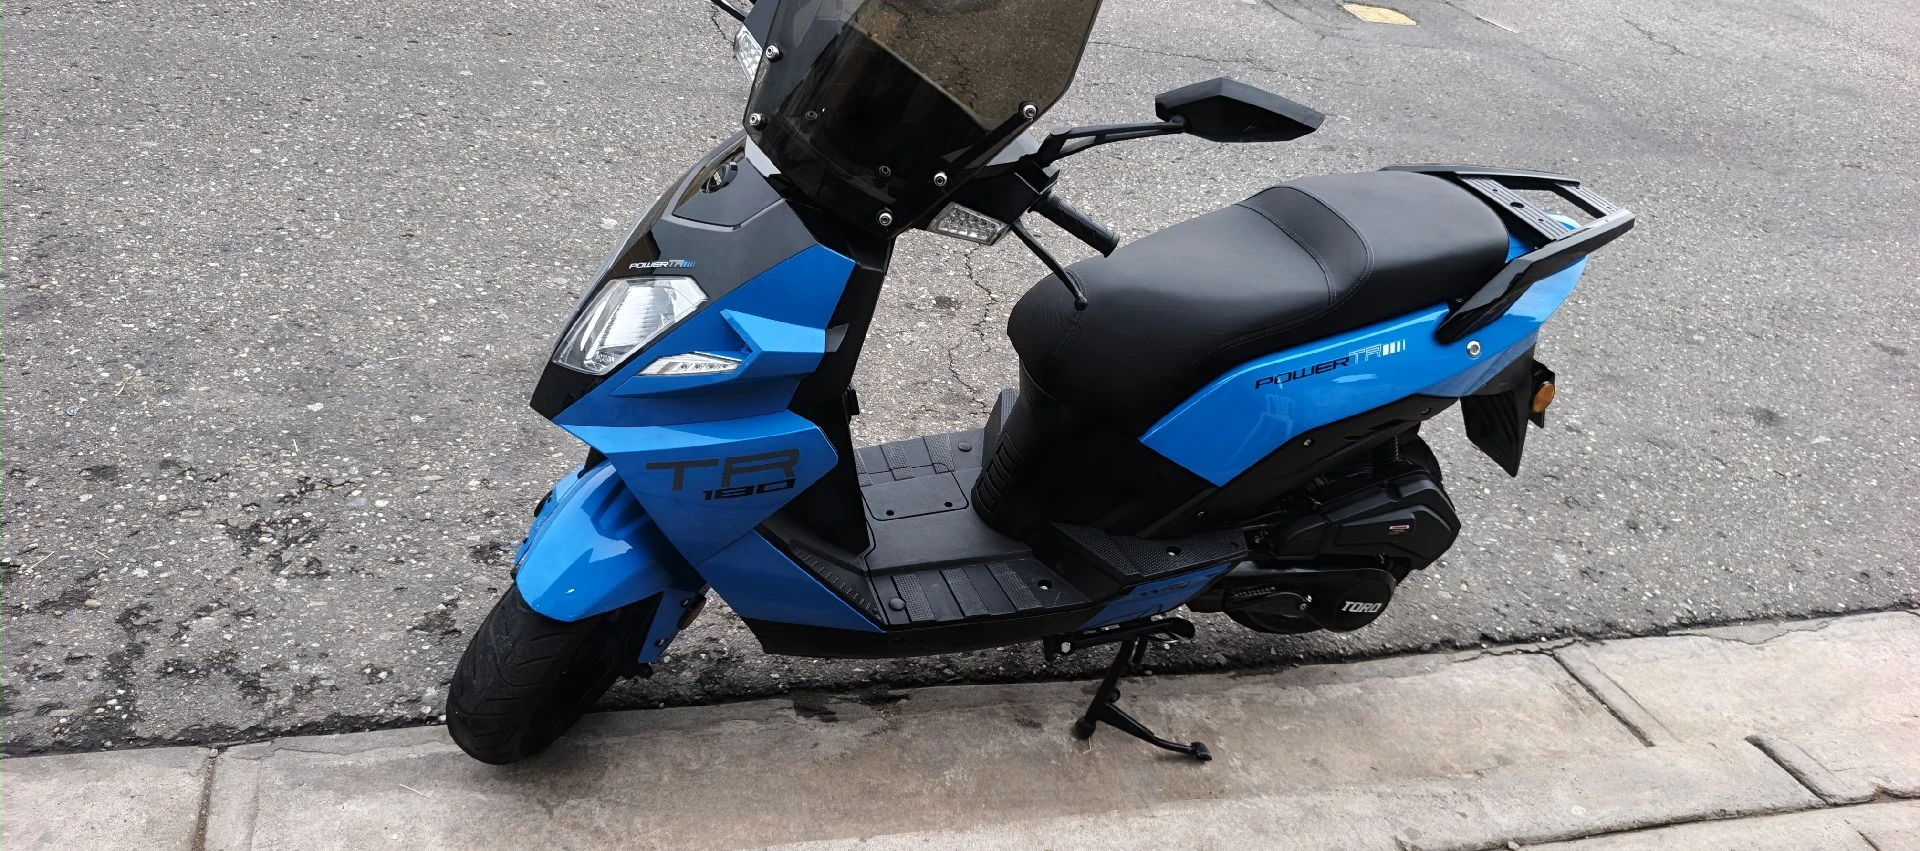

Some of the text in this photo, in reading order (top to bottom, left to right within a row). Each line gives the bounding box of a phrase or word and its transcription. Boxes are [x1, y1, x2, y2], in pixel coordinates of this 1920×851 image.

[646, 449, 800, 491] TR
[702, 478, 796, 500] 180
[1341, 601, 1382, 613] TORO
